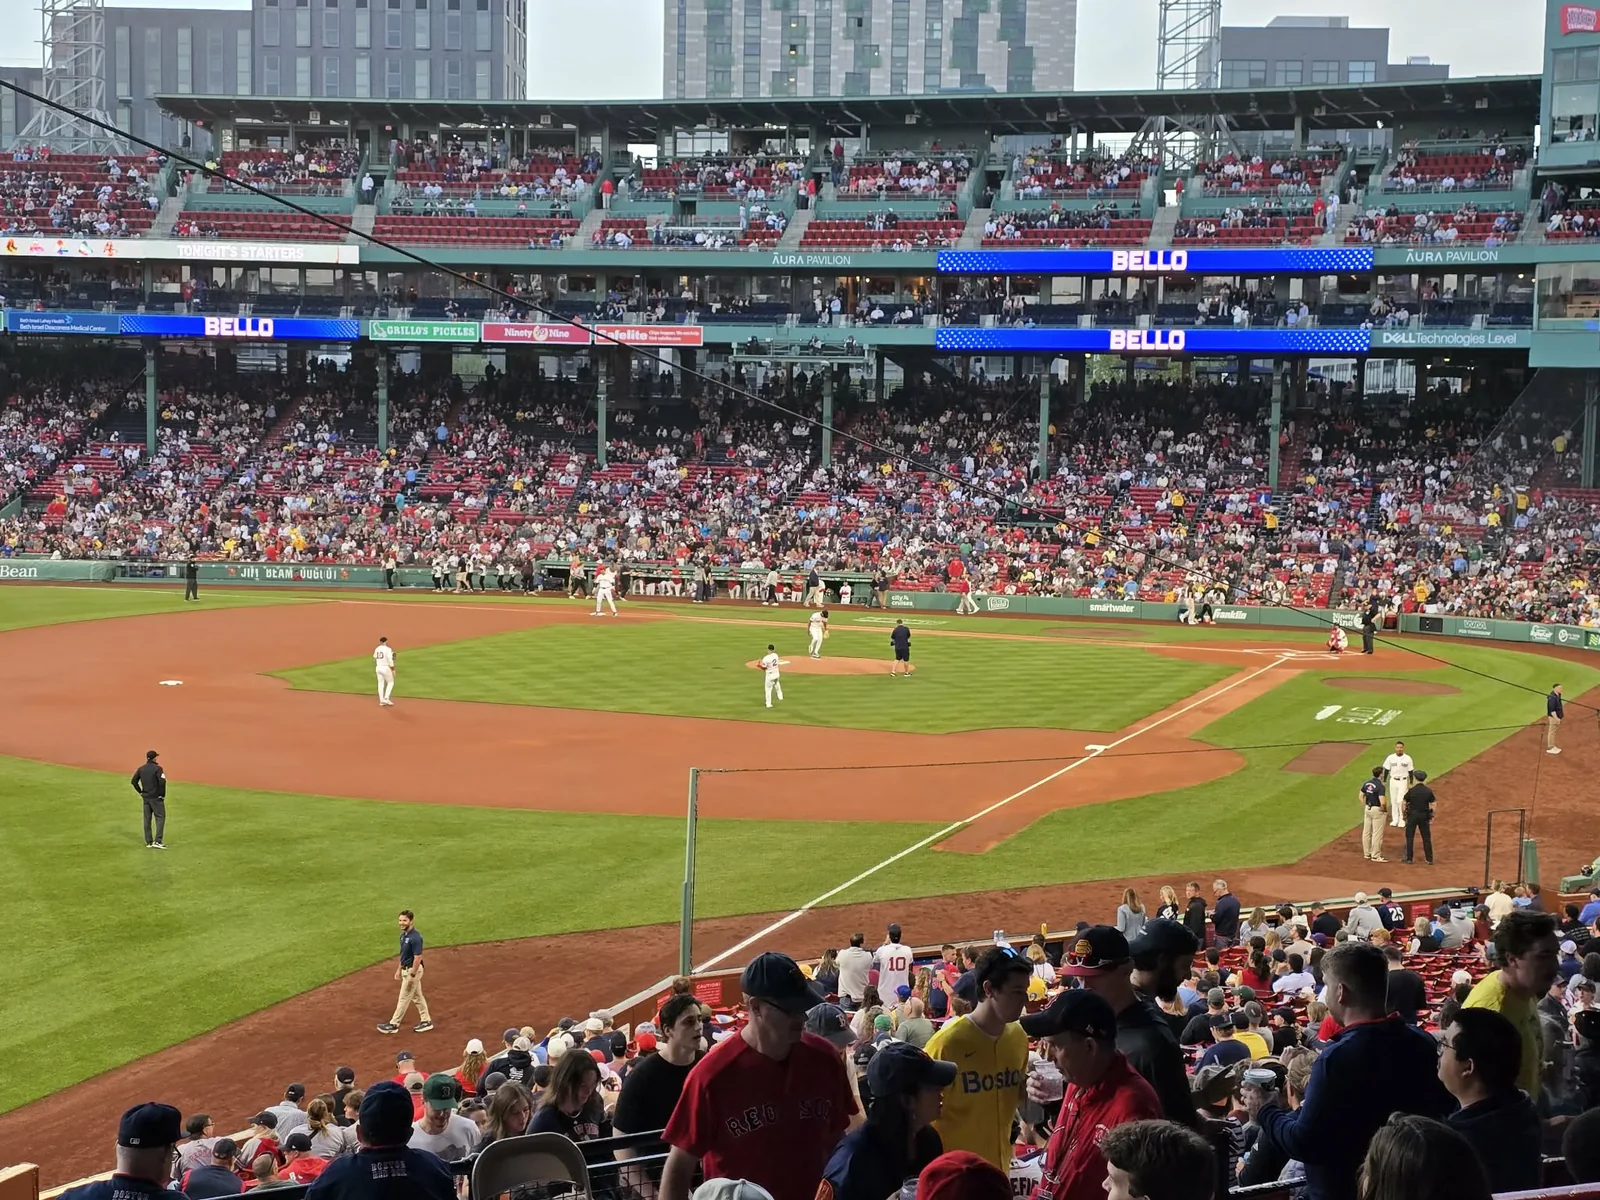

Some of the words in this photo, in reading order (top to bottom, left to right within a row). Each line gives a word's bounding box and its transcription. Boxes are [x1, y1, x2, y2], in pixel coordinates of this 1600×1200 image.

[177, 245, 238, 258] TONIGHT'S
[241, 246, 304, 260] STARTERS
[1446, 250, 1499, 262] PAVILION
[806, 255, 851, 265] PAVILION
[1112, 250, 1188, 271] BELLO
[205, 317, 274, 336] BELLO
[432, 327, 475, 337] PICKLES
[504, 328, 533, 339] Ninety
[549, 329, 569, 338] Nine
[597, 329, 648, 341] Safelite
[1109, 329, 1186, 350] BELLO
[1488, 332, 1517, 344] Level
[0, 565, 38, 578] Bean
[266, 568, 293, 579] BEAM
[1090, 603, 1135, 613] smartwater
[1213, 608, 1247, 619] Franklin
[1333, 612, 1354, 620] Ninety
[1333, 618, 1354, 626] Nine
[771, 658, 778, 666] 2
[1389, 907, 1404, 921] 25
[889, 957, 906, 971] 10
[961, 1067, 1021, 1094] Bosto
[725, 1102, 776, 1138] RED
